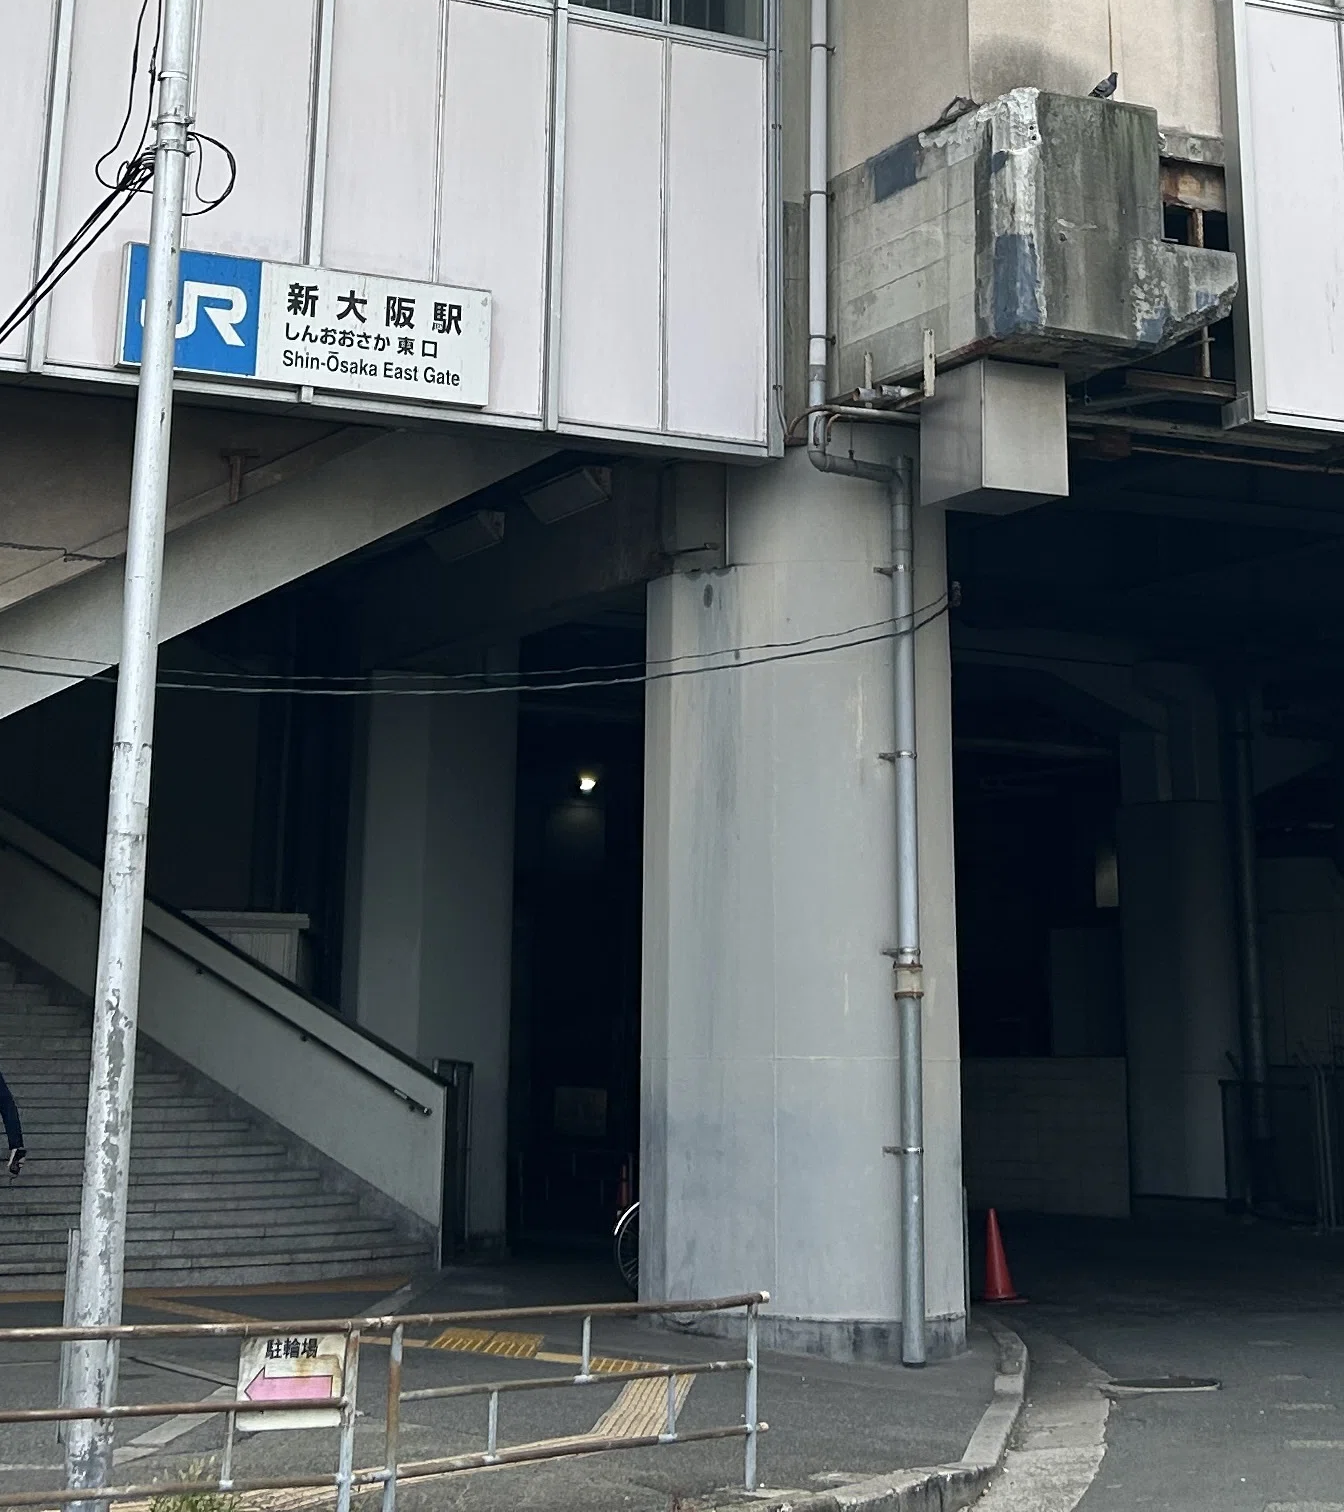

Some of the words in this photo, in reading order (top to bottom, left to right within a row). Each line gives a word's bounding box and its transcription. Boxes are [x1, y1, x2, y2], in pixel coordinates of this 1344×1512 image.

[286, 282, 464, 335] 新大阪駅
[284, 322, 391, 352] しんおおさか
[397, 337, 439, 359] 東口
[282, 350, 378, 378] Shin-Ōsaka
[383, 362, 419, 382] East
[424, 366, 461, 387] Gate
[265, 1337, 319, 1359] 駐輪場
